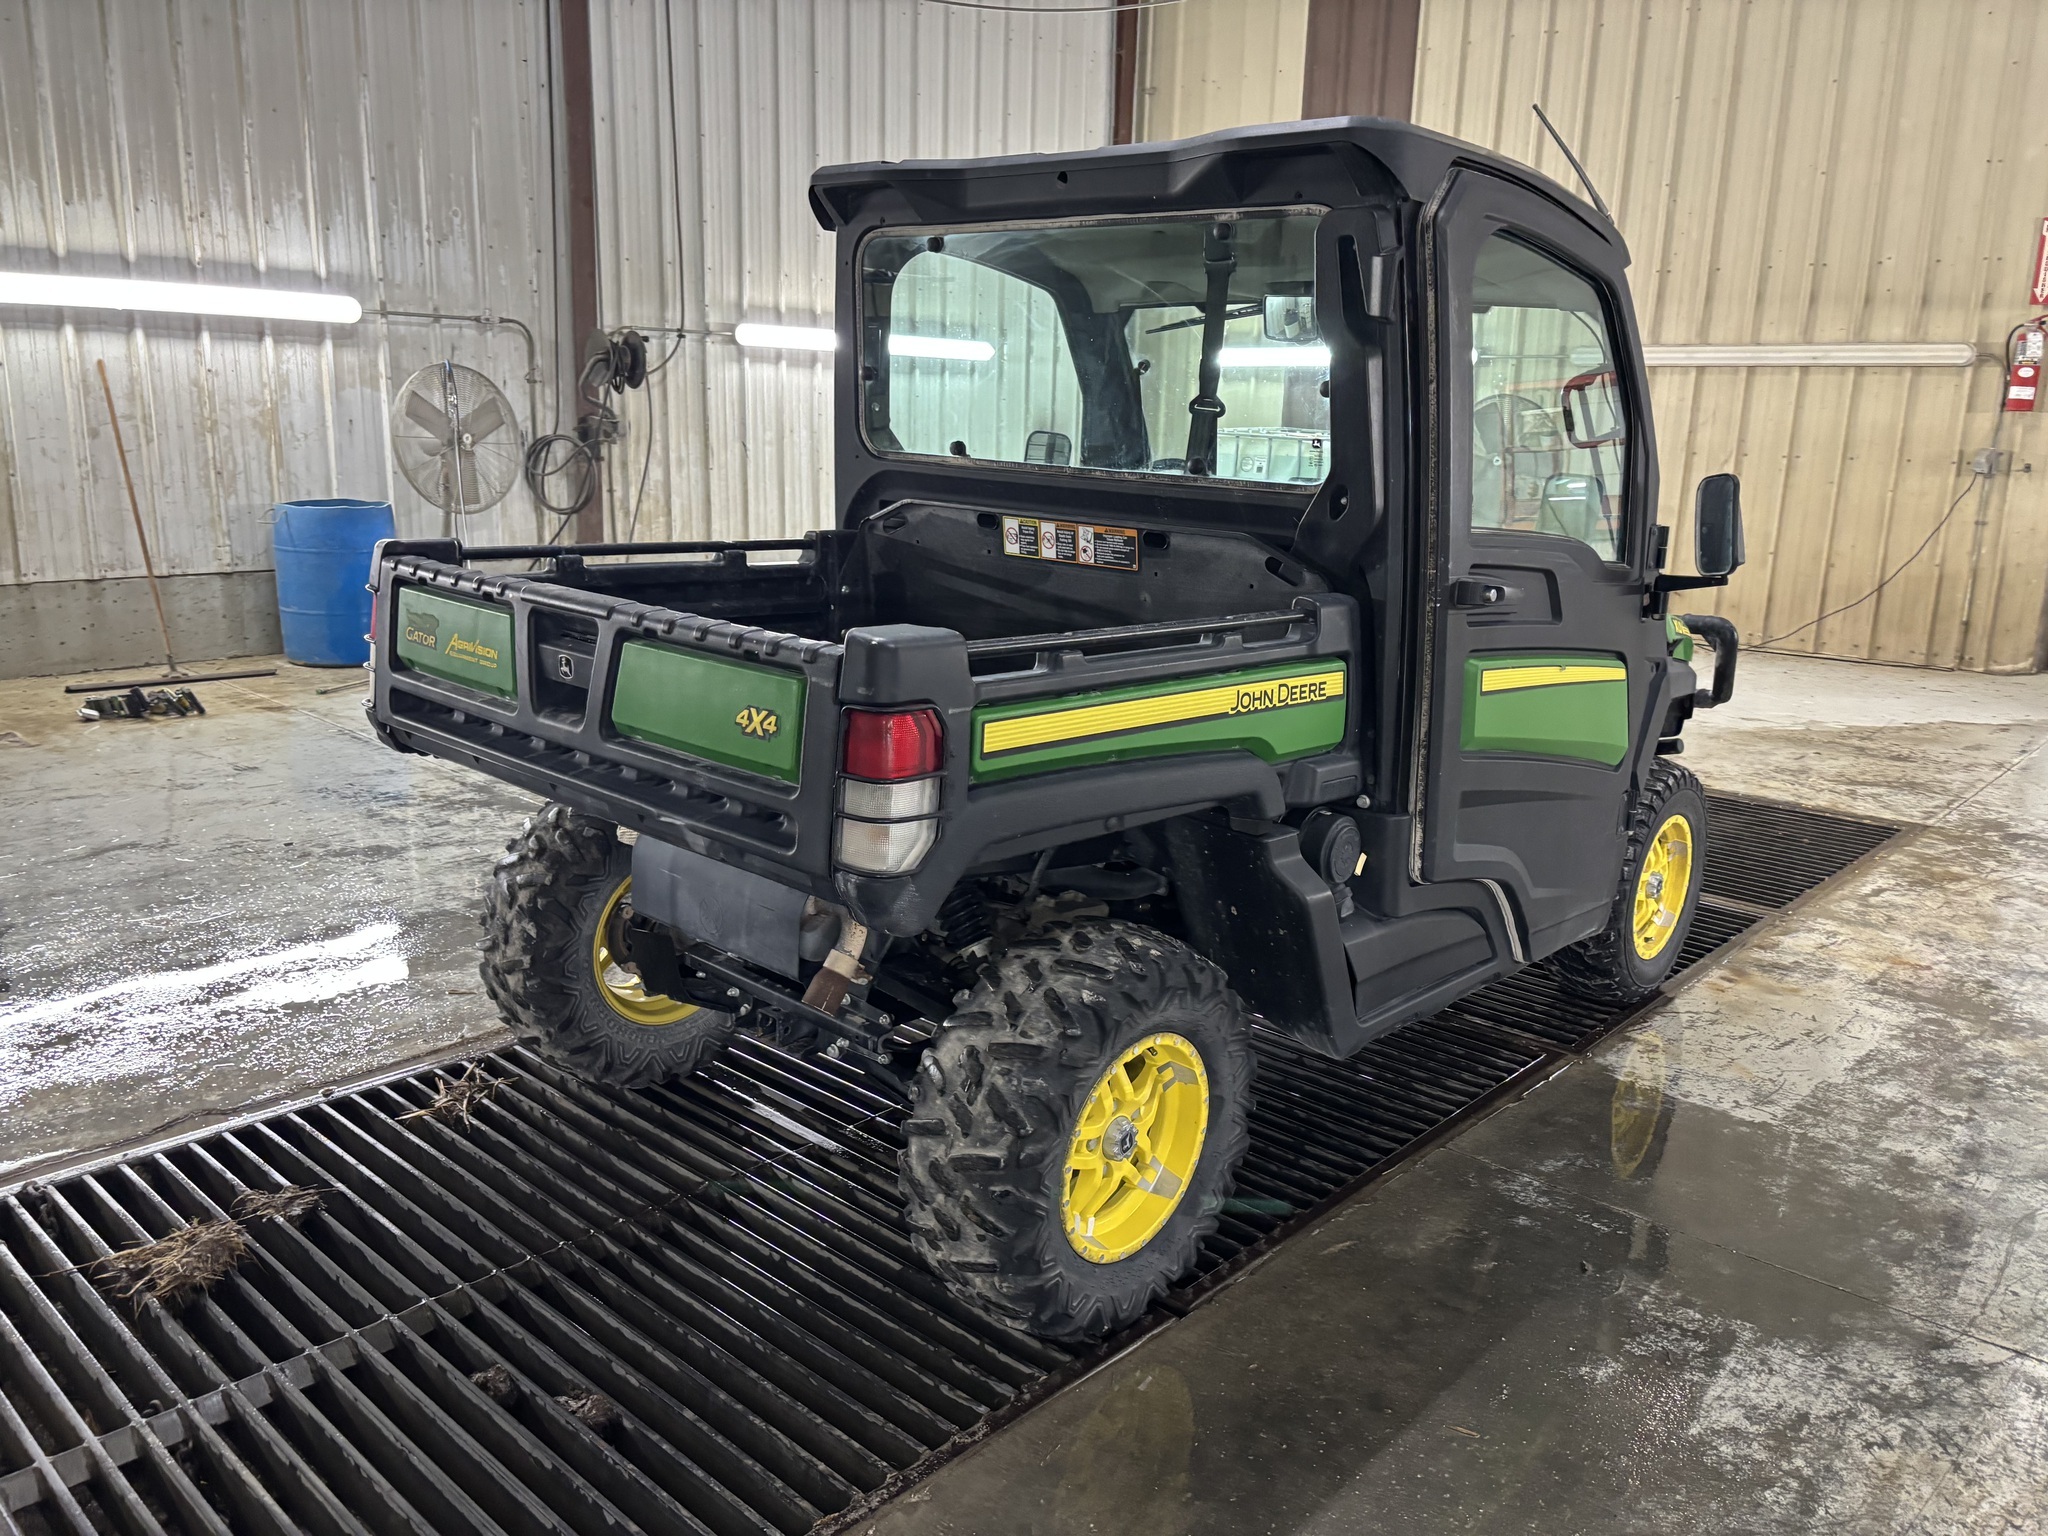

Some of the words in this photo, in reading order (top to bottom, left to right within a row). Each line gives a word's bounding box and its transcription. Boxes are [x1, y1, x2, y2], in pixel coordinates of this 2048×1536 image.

[406, 626, 436, 648] GATOR
[1229, 688, 1274, 713] JOHN
[1277, 681, 1328, 705] DEERE
[735, 707, 778, 737] 4X4
